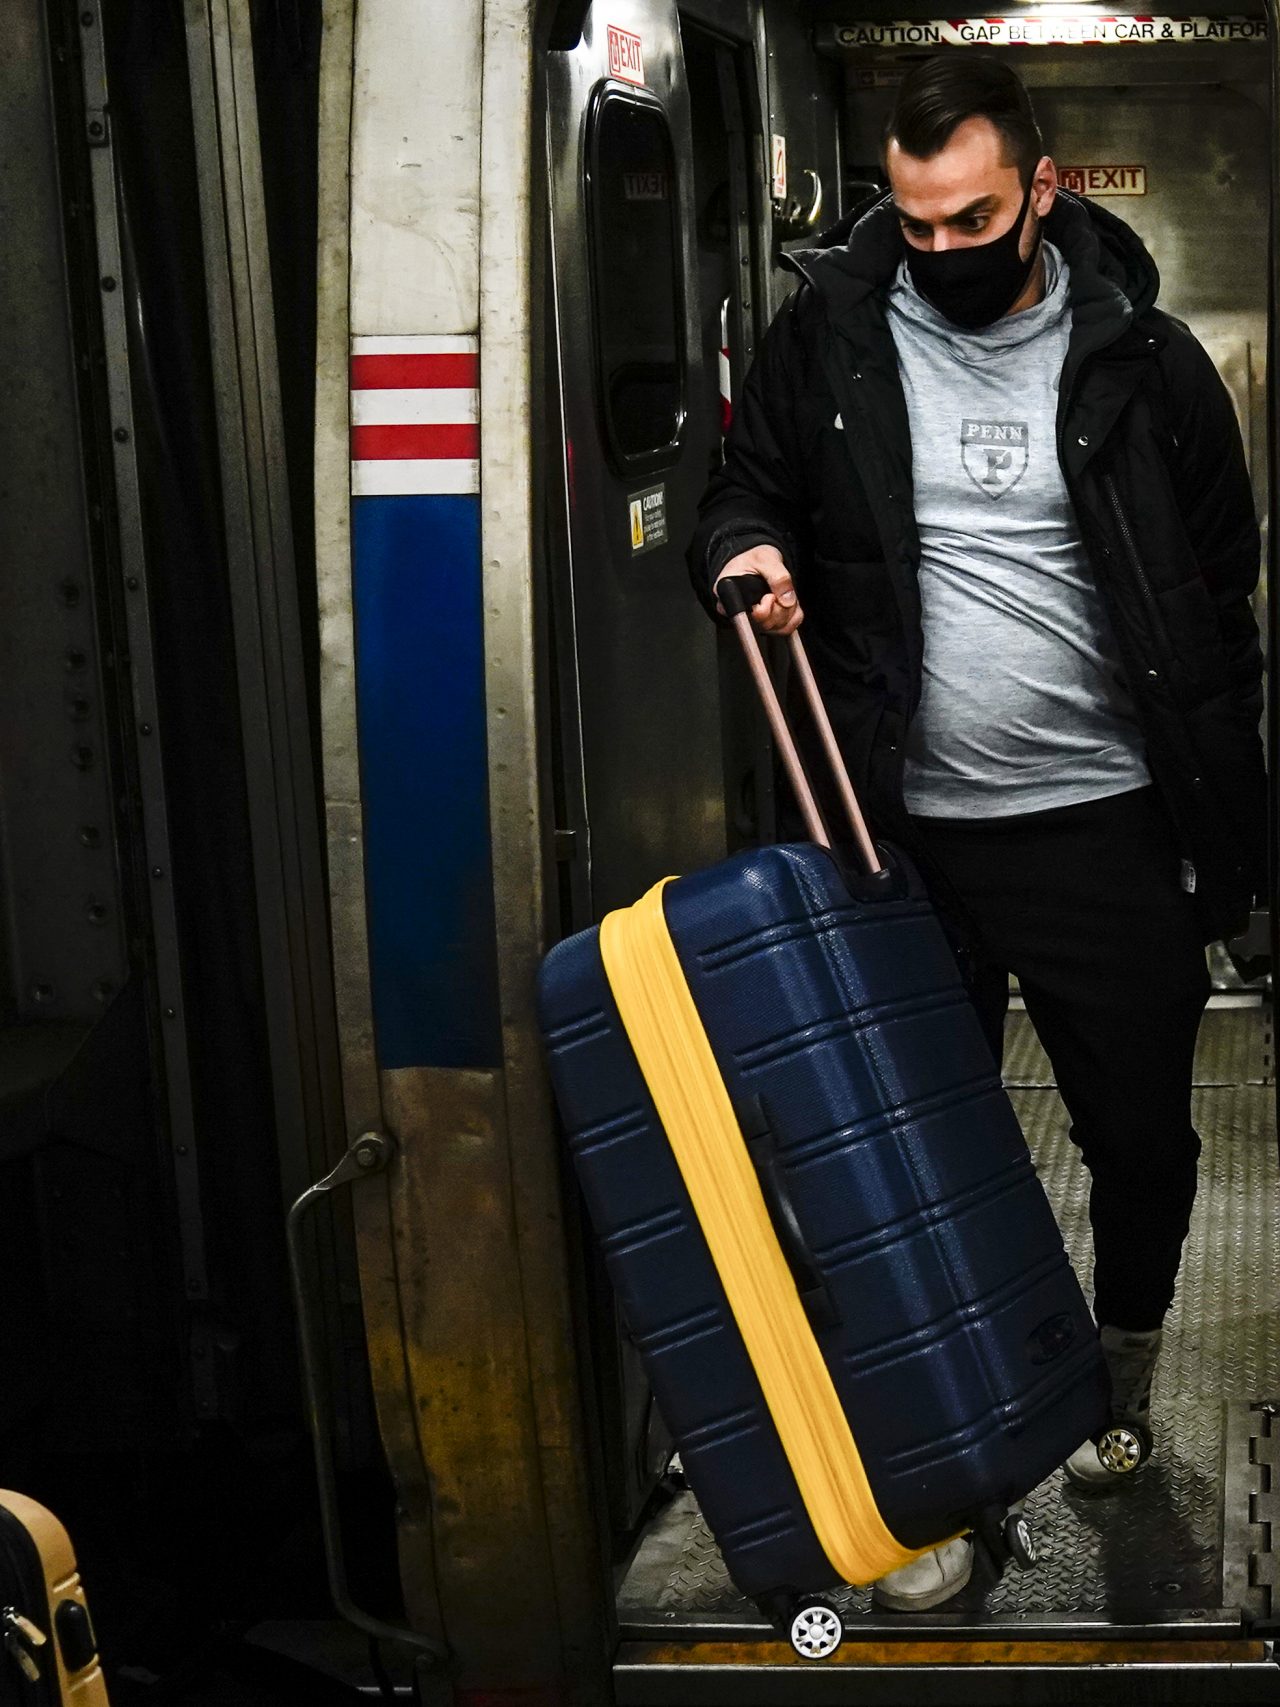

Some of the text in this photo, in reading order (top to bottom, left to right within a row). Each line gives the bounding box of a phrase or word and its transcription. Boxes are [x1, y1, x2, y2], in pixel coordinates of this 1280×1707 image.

[838, 25, 940, 43] CAUTION
[960, 25, 1001, 41] GAP
[1008, 24, 1106, 40] BETEEN
[1115, 23, 1154, 39] CAR
[1161, 23, 1174, 38] &
[619, 34, 641, 72] EXIT
[1088, 168, 1142, 189] EXIT
[966, 423, 1023, 441] PENN
[982, 448, 1013, 485] P
